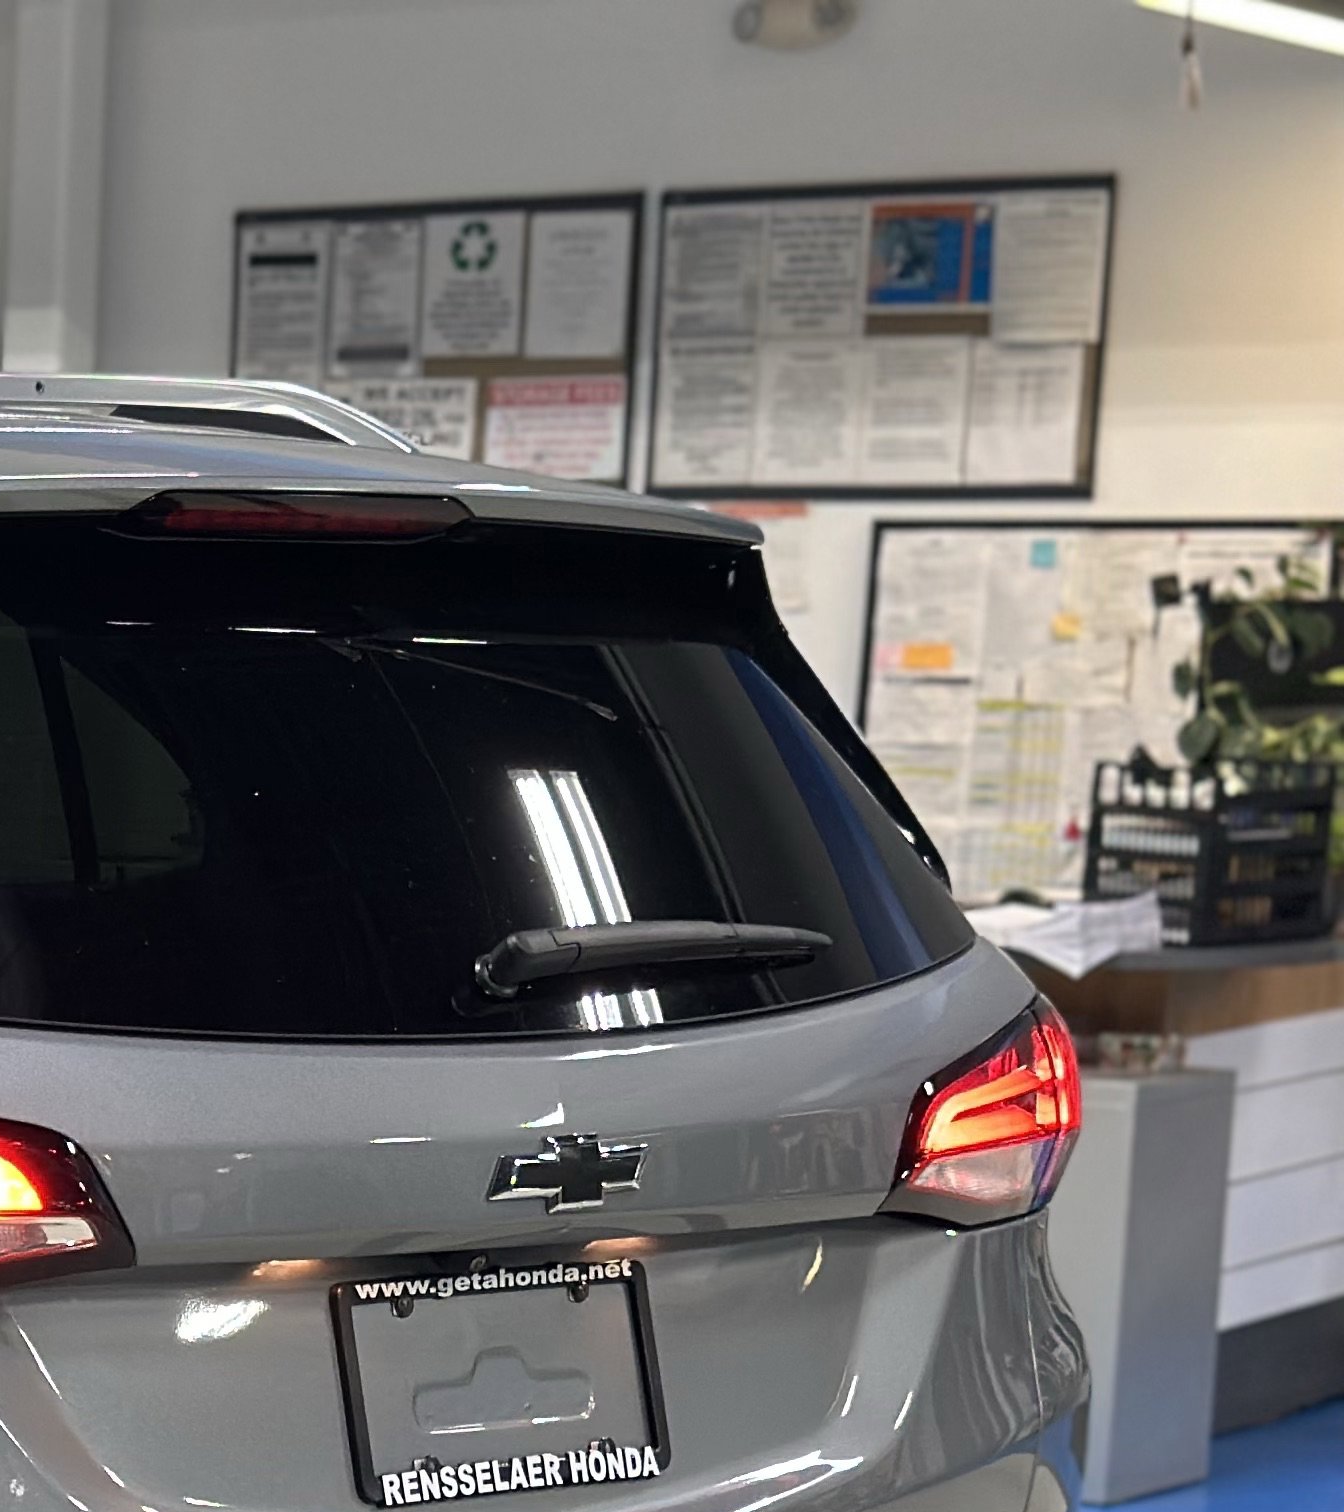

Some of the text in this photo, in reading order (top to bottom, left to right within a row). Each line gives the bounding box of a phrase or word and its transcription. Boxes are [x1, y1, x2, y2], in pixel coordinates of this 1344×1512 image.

[355, 1258, 632, 1300] www.getahonda.net
[382, 1445, 661, 1506] RENSSELAER HONDA
